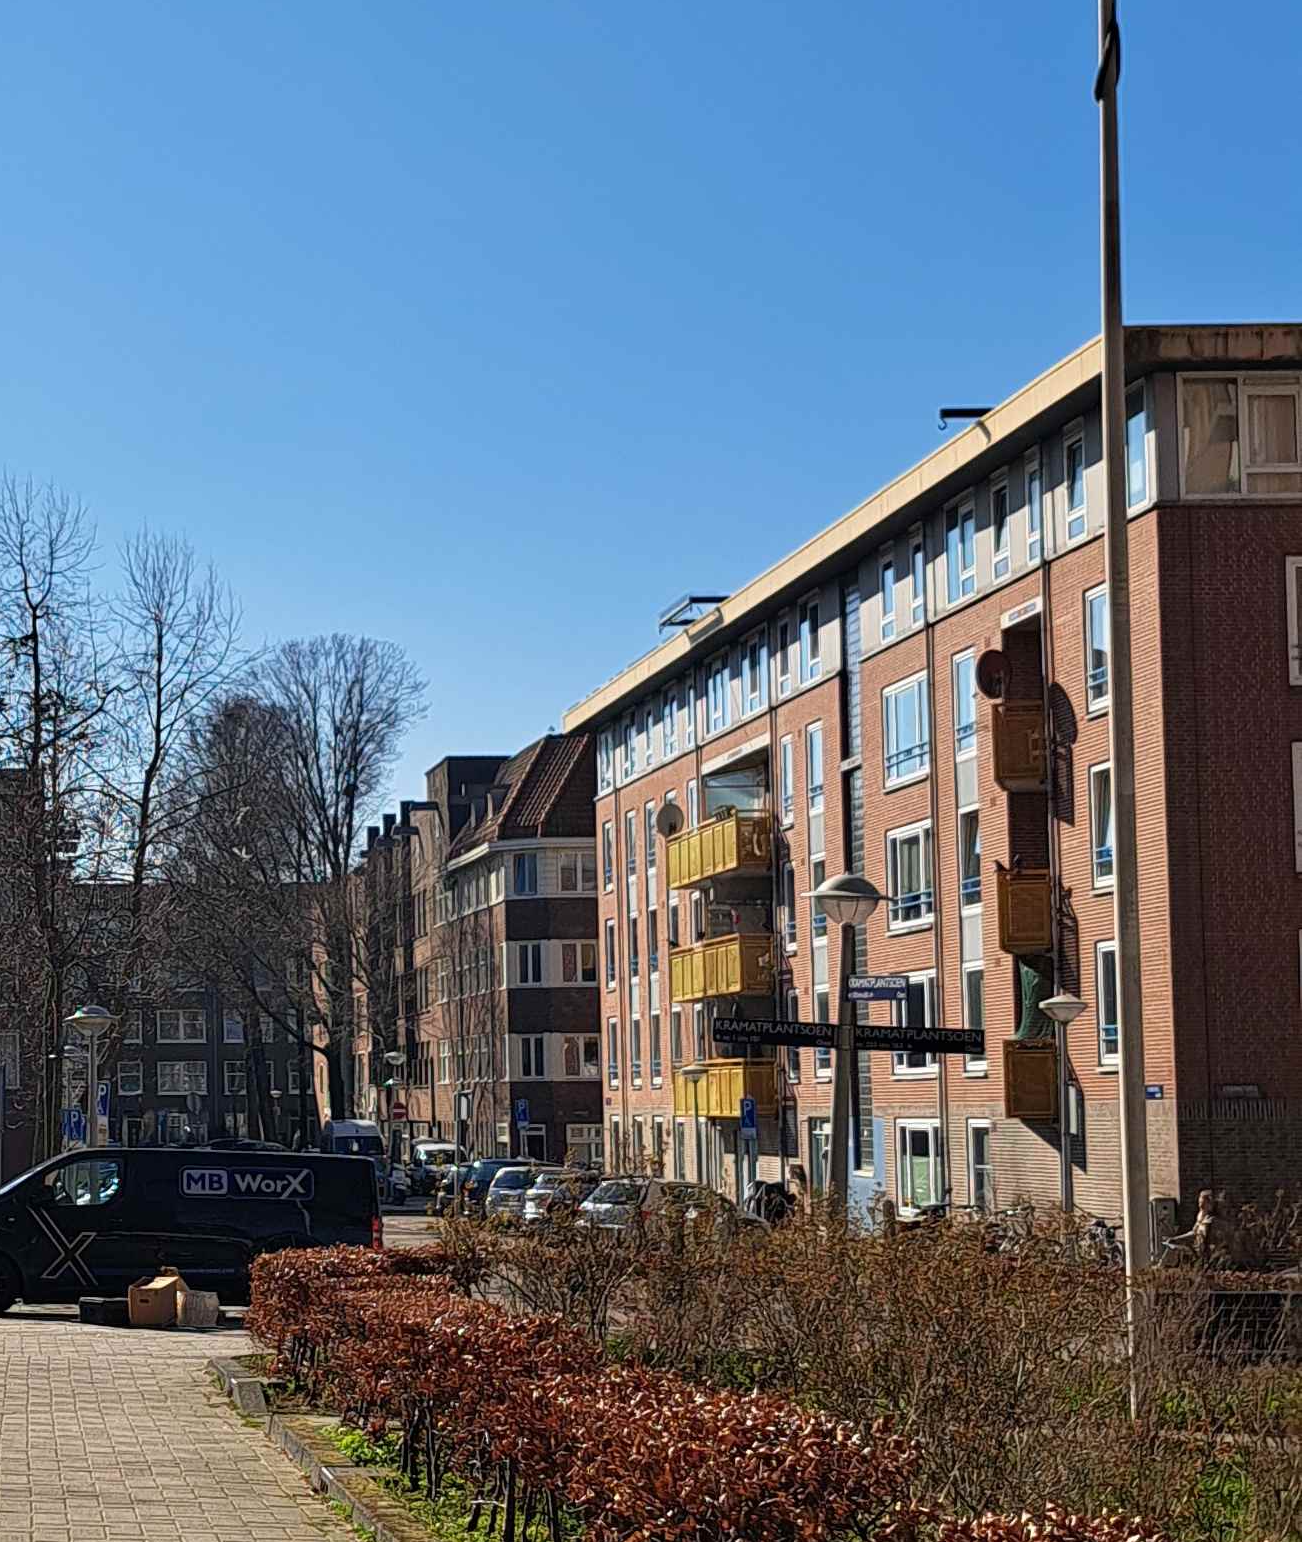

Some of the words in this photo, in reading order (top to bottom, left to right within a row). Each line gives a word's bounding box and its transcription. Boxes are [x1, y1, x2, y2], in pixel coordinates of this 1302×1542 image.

[714, 1019, 833, 1036] KRAMATPLANTSOEN
[855, 1027, 982, 1043] KRAMATPLANTSOEN
[185, 1172, 225, 1192] MB
[234, 1168, 310, 1199] WorX
